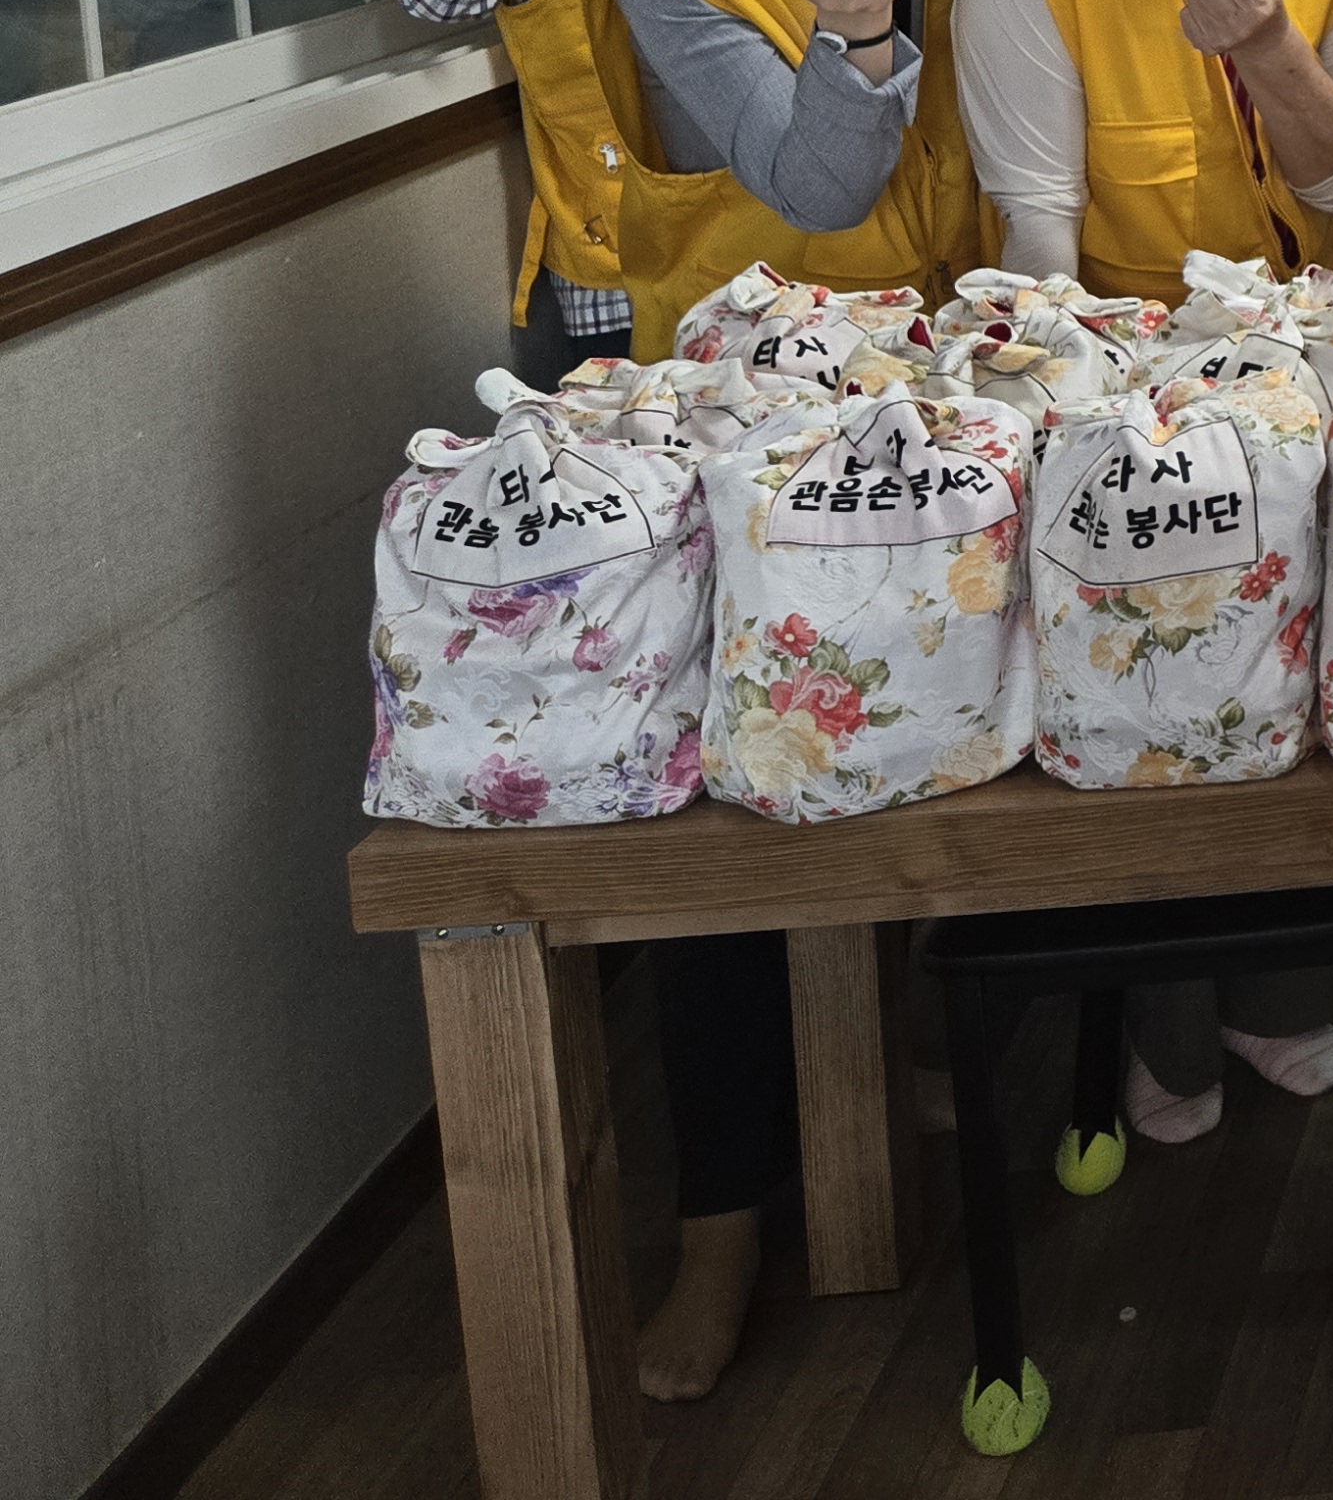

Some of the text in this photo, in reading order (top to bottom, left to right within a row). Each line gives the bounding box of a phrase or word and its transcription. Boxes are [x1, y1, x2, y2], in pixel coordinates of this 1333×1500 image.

[435, 493, 628, 549] 관음 봉사단
[789, 476, 903, 513] 관음손
[1126, 491, 1242, 550] 봉사단
